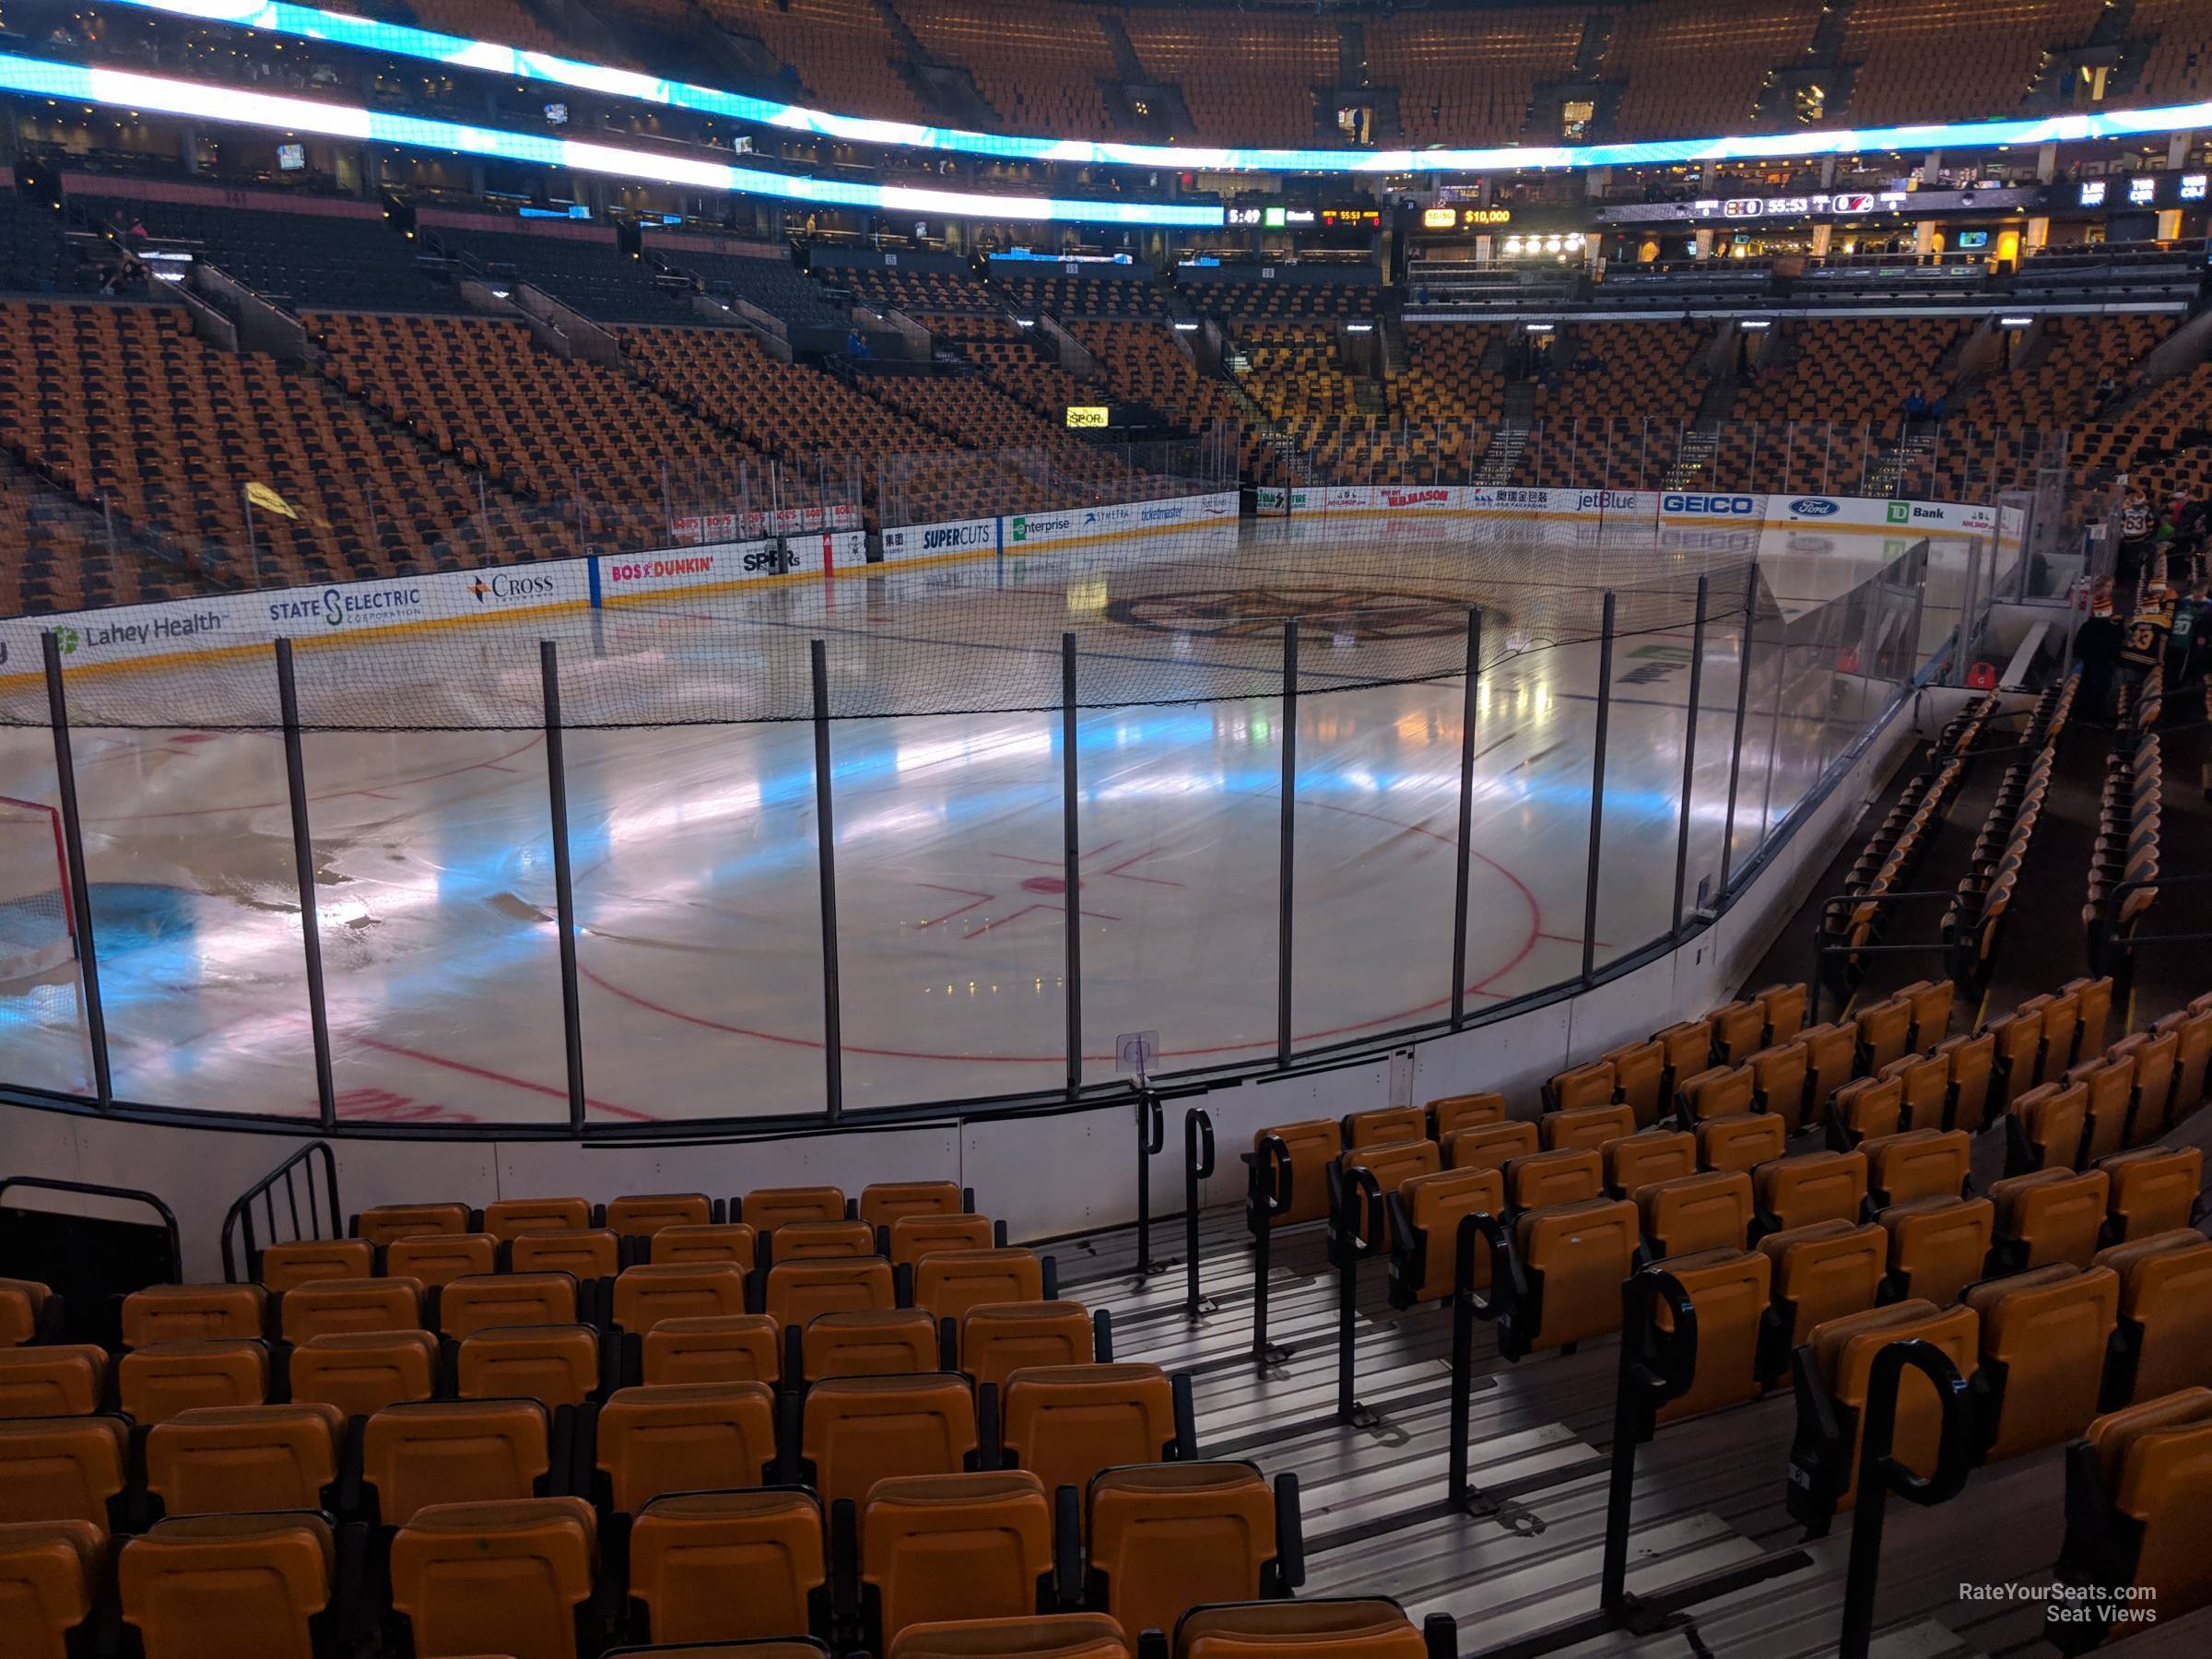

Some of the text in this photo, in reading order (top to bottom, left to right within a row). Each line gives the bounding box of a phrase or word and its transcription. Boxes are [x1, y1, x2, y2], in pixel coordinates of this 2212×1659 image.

[1769, 198, 1807, 213] 55:53
[1229, 208, 1261, 223] 5:49
[1465, 209, 1511, 224] $10,000
[1577, 490, 1636, 511] jetBlue
[1664, 495, 1754, 514] GEICO
[1798, 500, 1830, 514] Ford
[1890, 505, 1944, 520] TD Bank
[1016, 517, 1070, 535] enterprise
[2126, 515, 2144, 531] 63
[923, 524, 990, 549] SUPERCUTS
[611, 556, 713, 582] BOS DUNKIN'
[270, 600, 321, 621] STATE
[345, 589, 421, 612] ELECTRIC
[86, 611, 222, 647] Lahey Health
